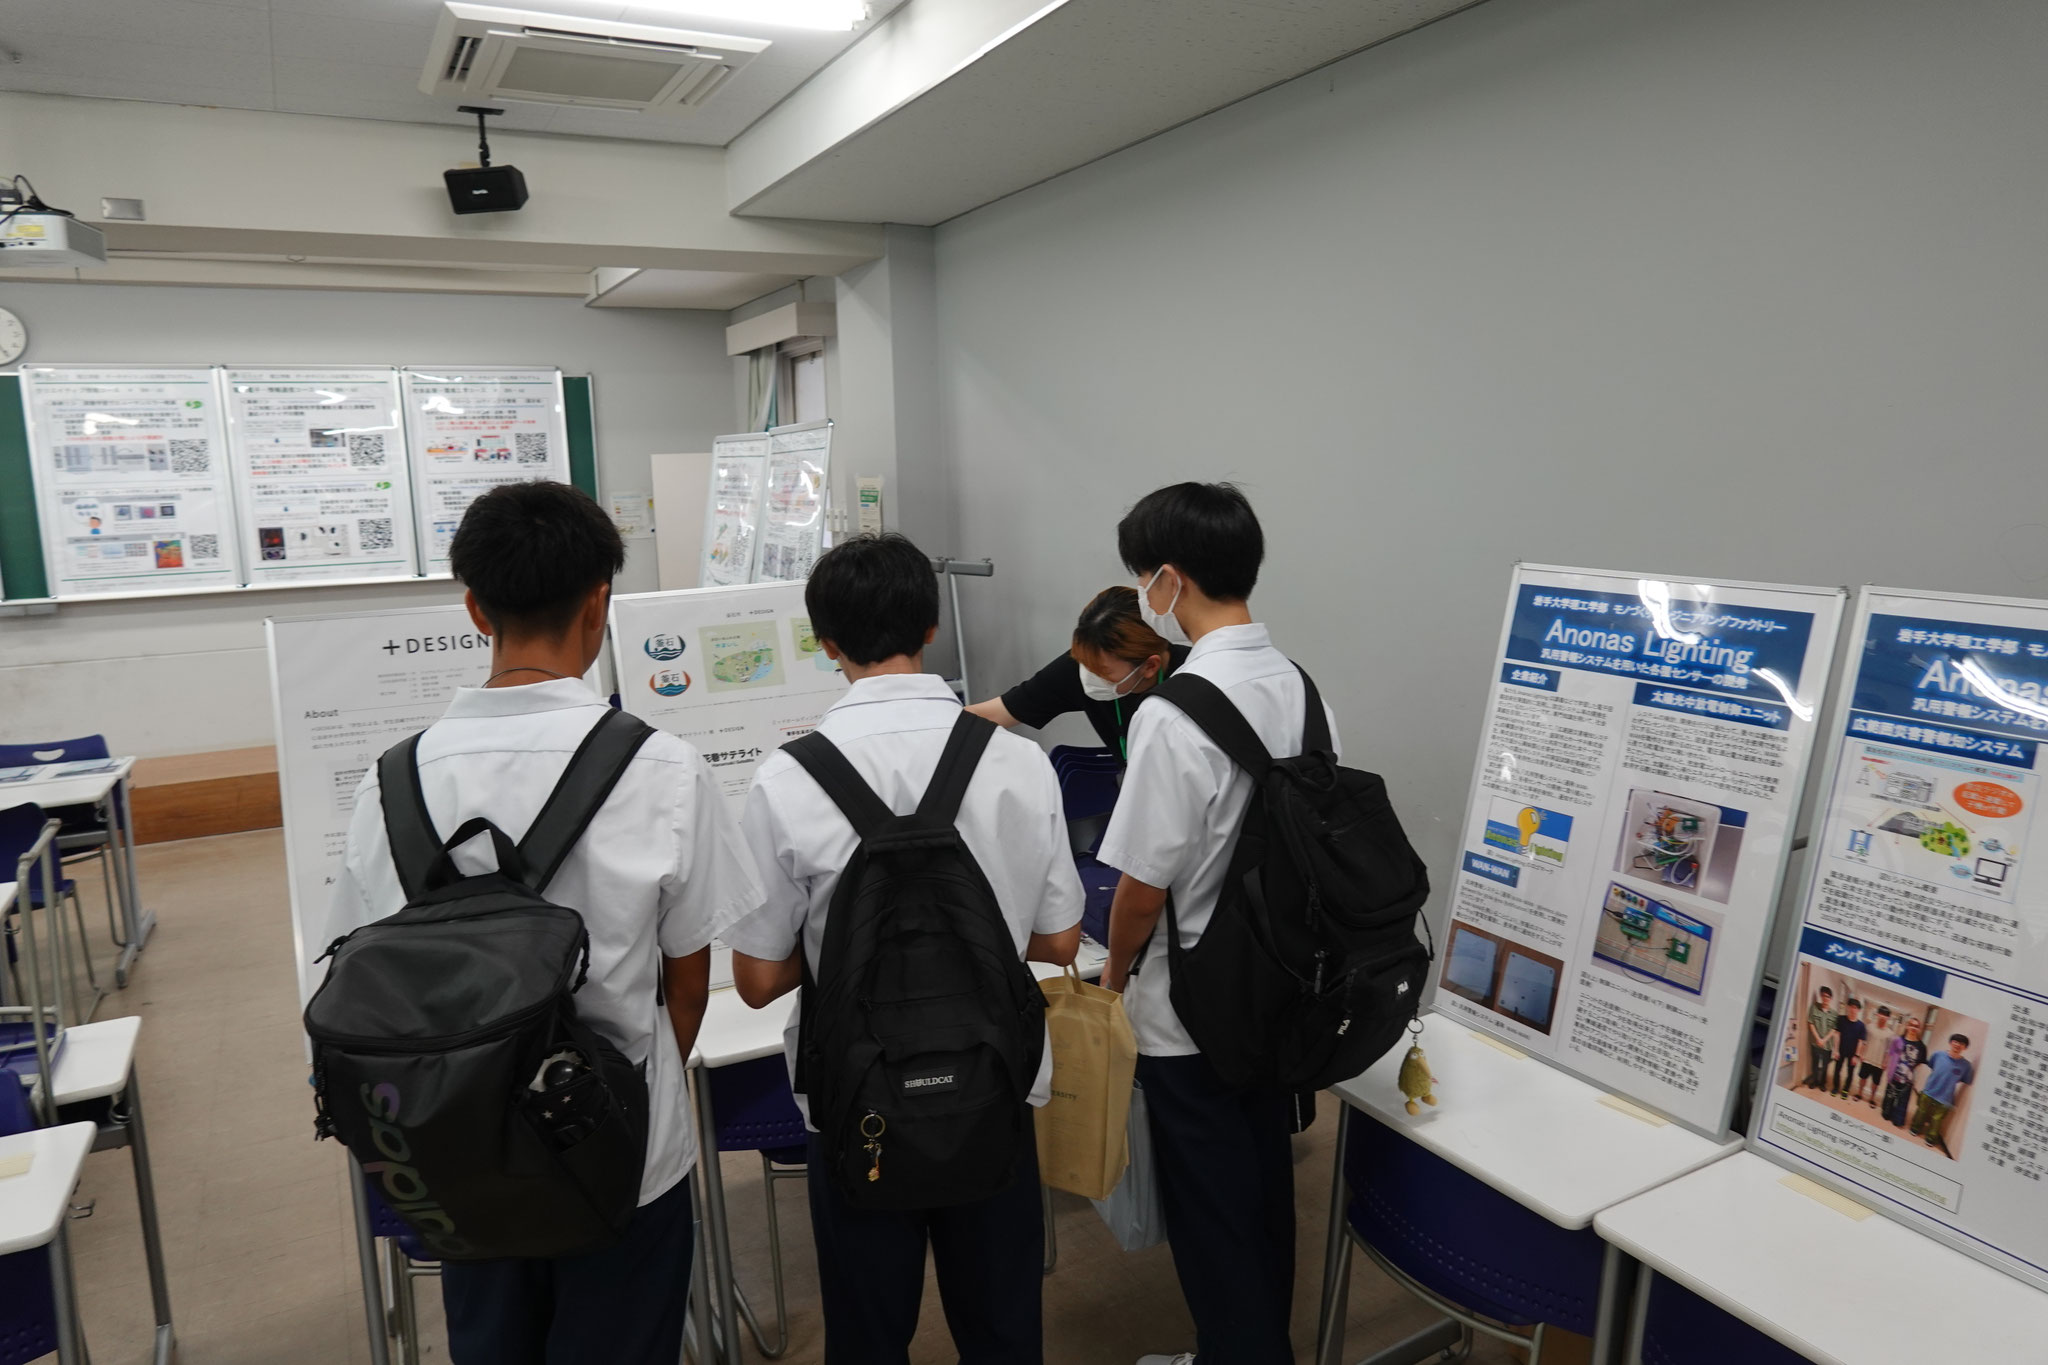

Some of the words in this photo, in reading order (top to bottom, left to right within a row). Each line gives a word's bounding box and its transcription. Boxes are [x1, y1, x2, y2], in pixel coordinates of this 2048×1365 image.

[1533, 594, 1609, 615] 岩手大学理工学部
[1613, 602, 1788, 633] モノづくりジニアリングファクトリー
[383, 634, 490, 656] +DESIGN
[655, 638, 674, 648] 釜石
[1545, 617, 1635, 653] Anonas
[1643, 630, 1754, 671] Lighting
[1897, 628, 2020, 655] 岩手大学理工学部
[304, 709, 339, 720] About
[702, 747, 763, 763] 花巻サテライト
[1471, 858, 1510, 878] WAN-WAN
[1825, 943, 1905, 975] メンバー紹介
[1337, 1019, 1351, 1035] FILA
[904, 1075, 954, 1088] SHOULDCAT
[360, 1082, 474, 1255] adidas
